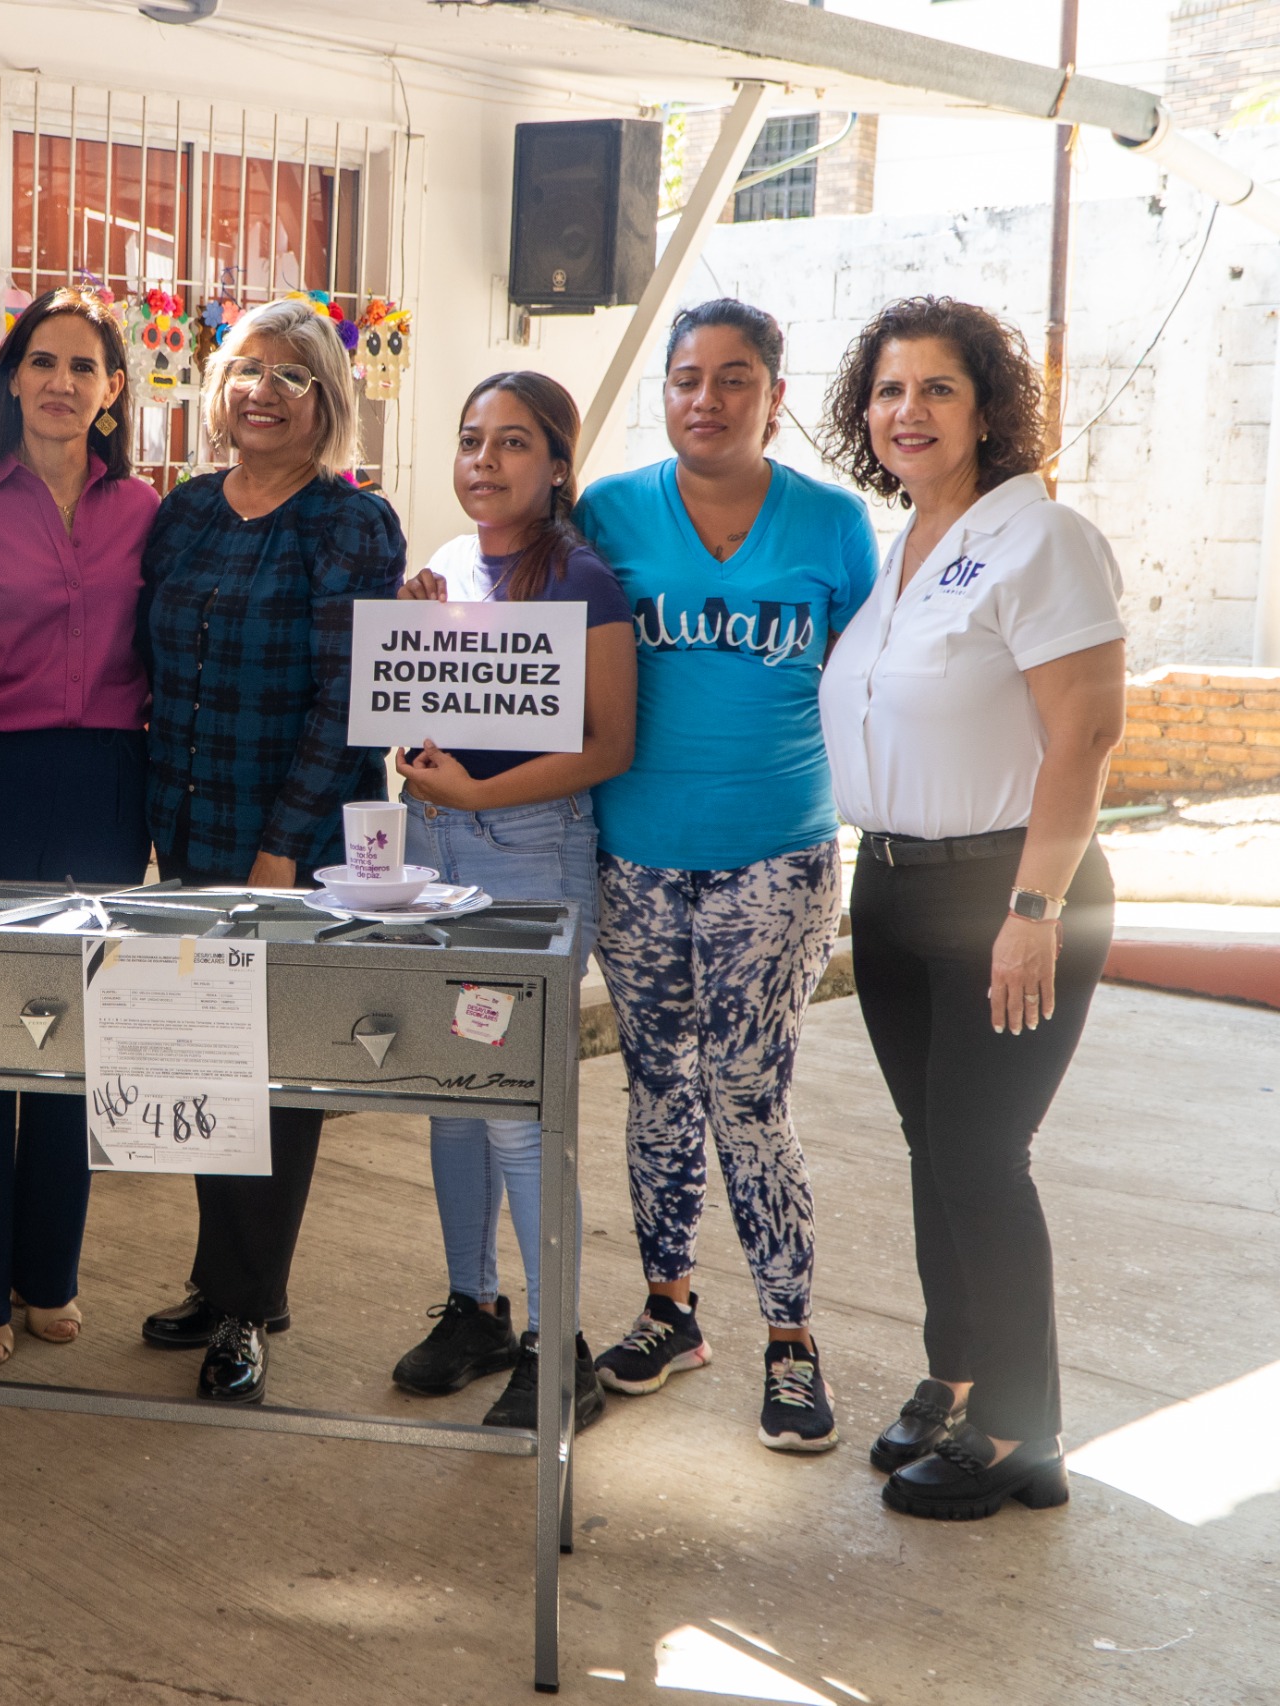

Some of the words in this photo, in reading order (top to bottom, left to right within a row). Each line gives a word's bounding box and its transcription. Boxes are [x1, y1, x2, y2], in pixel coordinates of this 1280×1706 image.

[632, 593, 814, 666] always
[381, 630, 553, 654] JN.MELIDA
[373, 660, 561, 686] RODRIGUEZ
[371, 691, 411, 713] DE
[421, 692, 560, 716] SALINAS
[350, 843, 366, 852] todas
[229, 952, 255, 967] DIF
